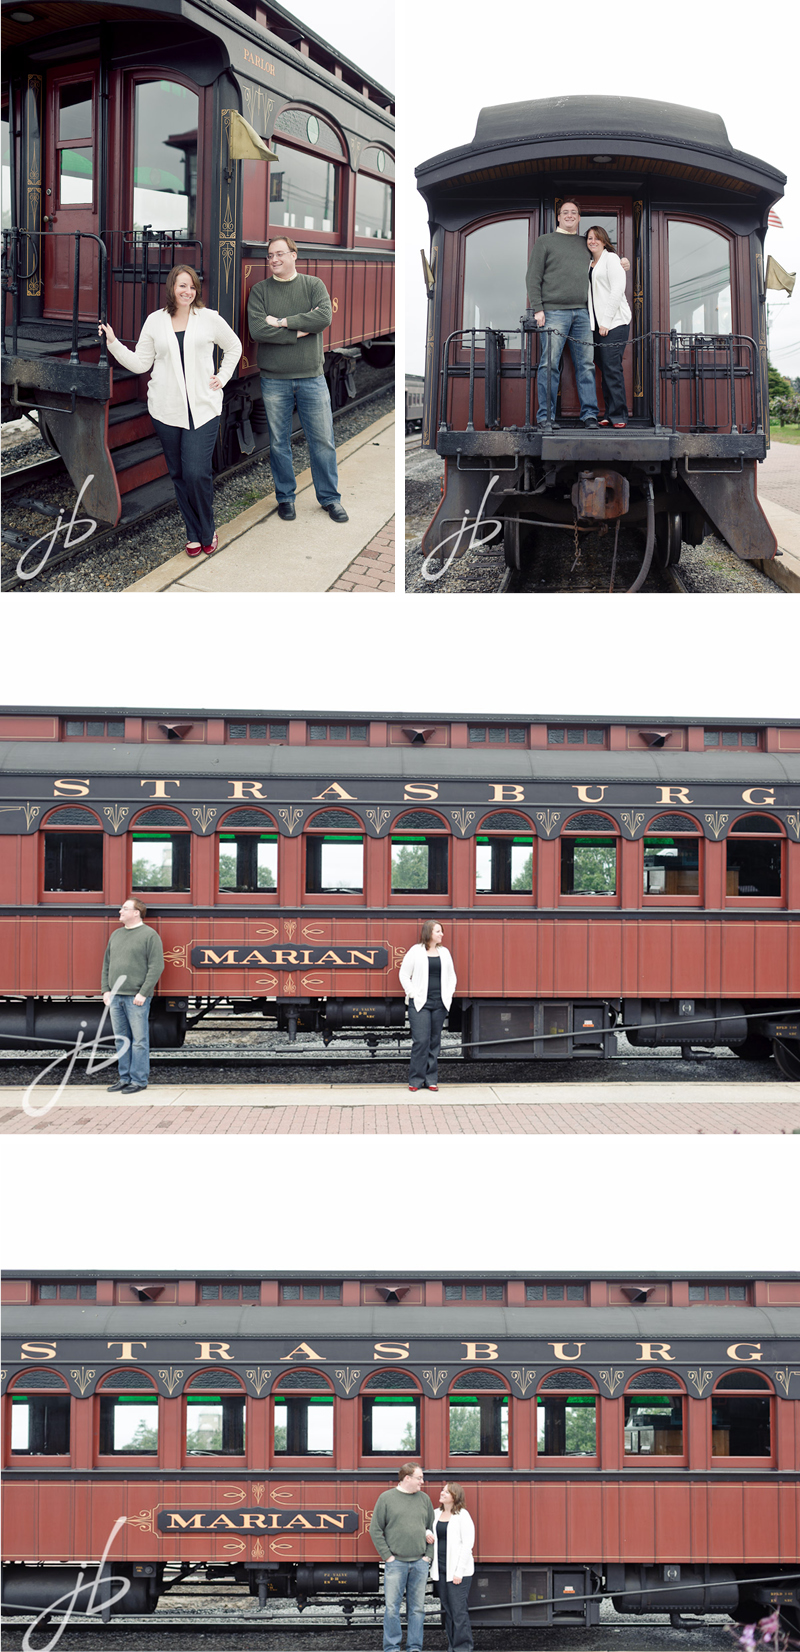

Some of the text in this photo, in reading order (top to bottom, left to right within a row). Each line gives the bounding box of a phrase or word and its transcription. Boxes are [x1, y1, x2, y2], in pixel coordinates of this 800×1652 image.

[243, 48, 275, 76] PARLOR
[332, 297, 339, 313] 8
[53, 778, 777, 806] STRASBURG
[199, 949, 380, 965] MARIAN
[20, 1341, 764, 1362] STRASBURG
[166, 1513, 349, 1529] MARIAN
